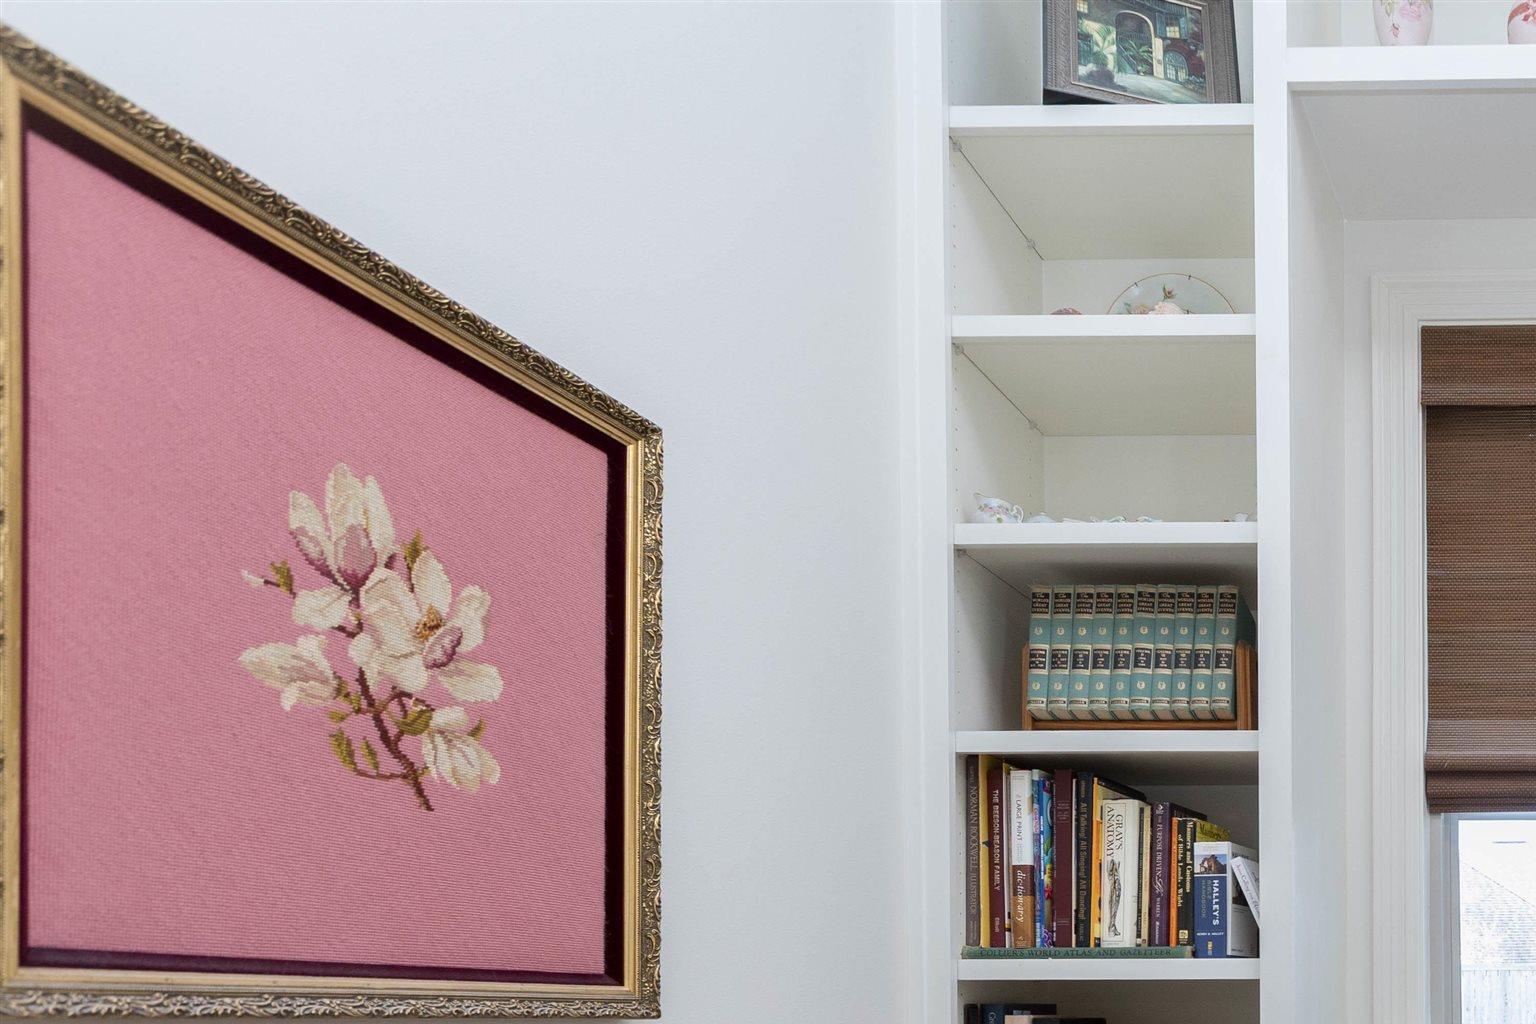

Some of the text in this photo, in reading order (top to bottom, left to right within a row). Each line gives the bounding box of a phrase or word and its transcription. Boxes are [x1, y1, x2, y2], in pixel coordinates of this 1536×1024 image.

[969, 786, 978, 825] NORMAN
[969, 826, 978, 871] ROCKWELL
[1106, 806, 1115, 859] ANATOMY
[1115, 814, 1124, 851] GRAY'S
[1185, 821, 1194, 849] Manners
[1185, 866, 1193, 893] Customs
